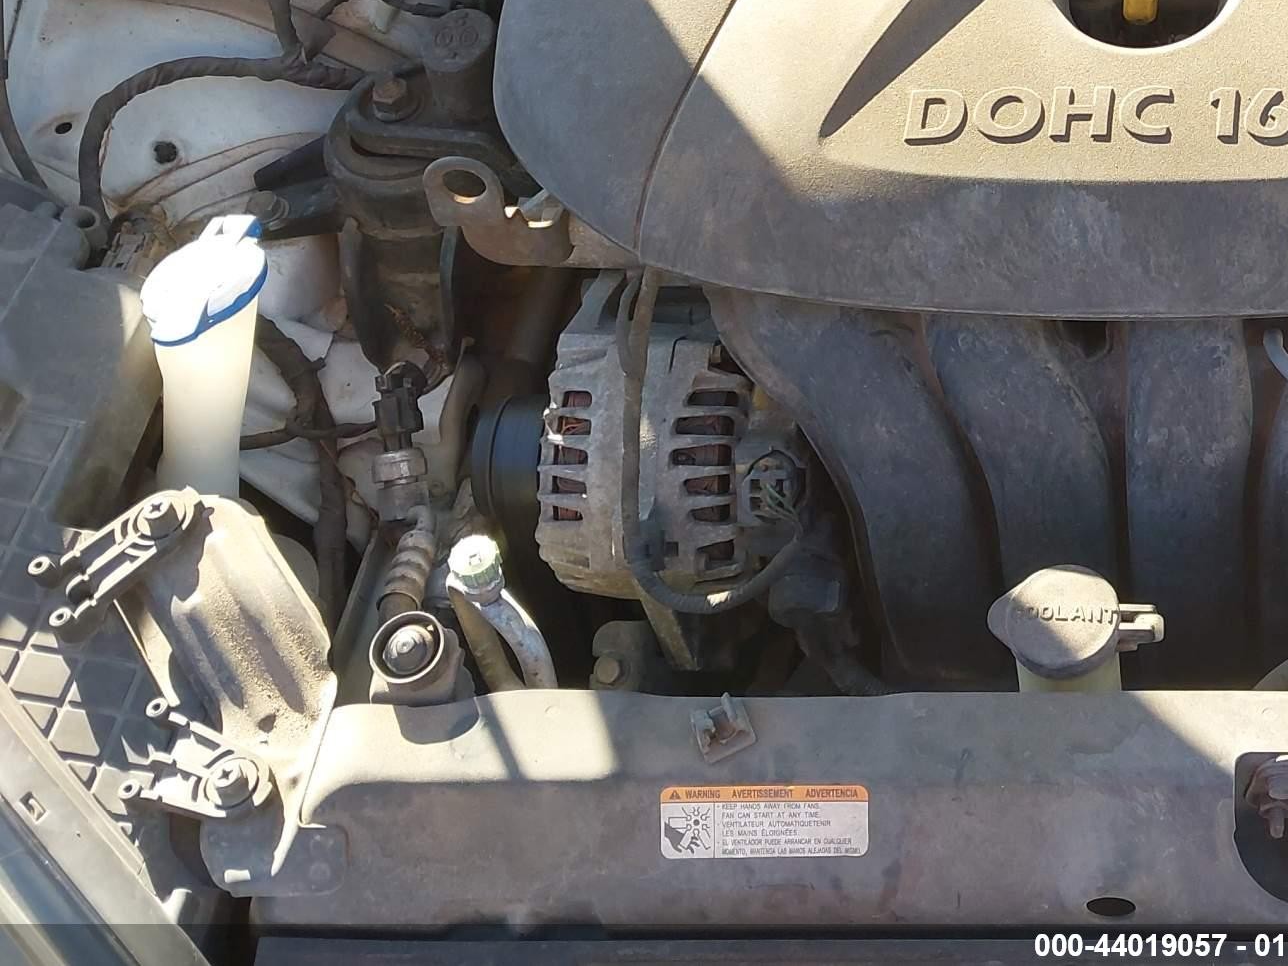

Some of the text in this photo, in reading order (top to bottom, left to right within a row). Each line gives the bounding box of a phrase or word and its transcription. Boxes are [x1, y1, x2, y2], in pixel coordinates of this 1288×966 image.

[903, 87, 1175, 146] DOHC
[1013, 604, 1119, 625] COOLANT
[685, 788, 858, 799] WARNING AVERTISSEMENT ADVERTENCIA
[731, 838, 762, 846] VENTILADOR
[823, 837, 852, 845] CUALQUIER
